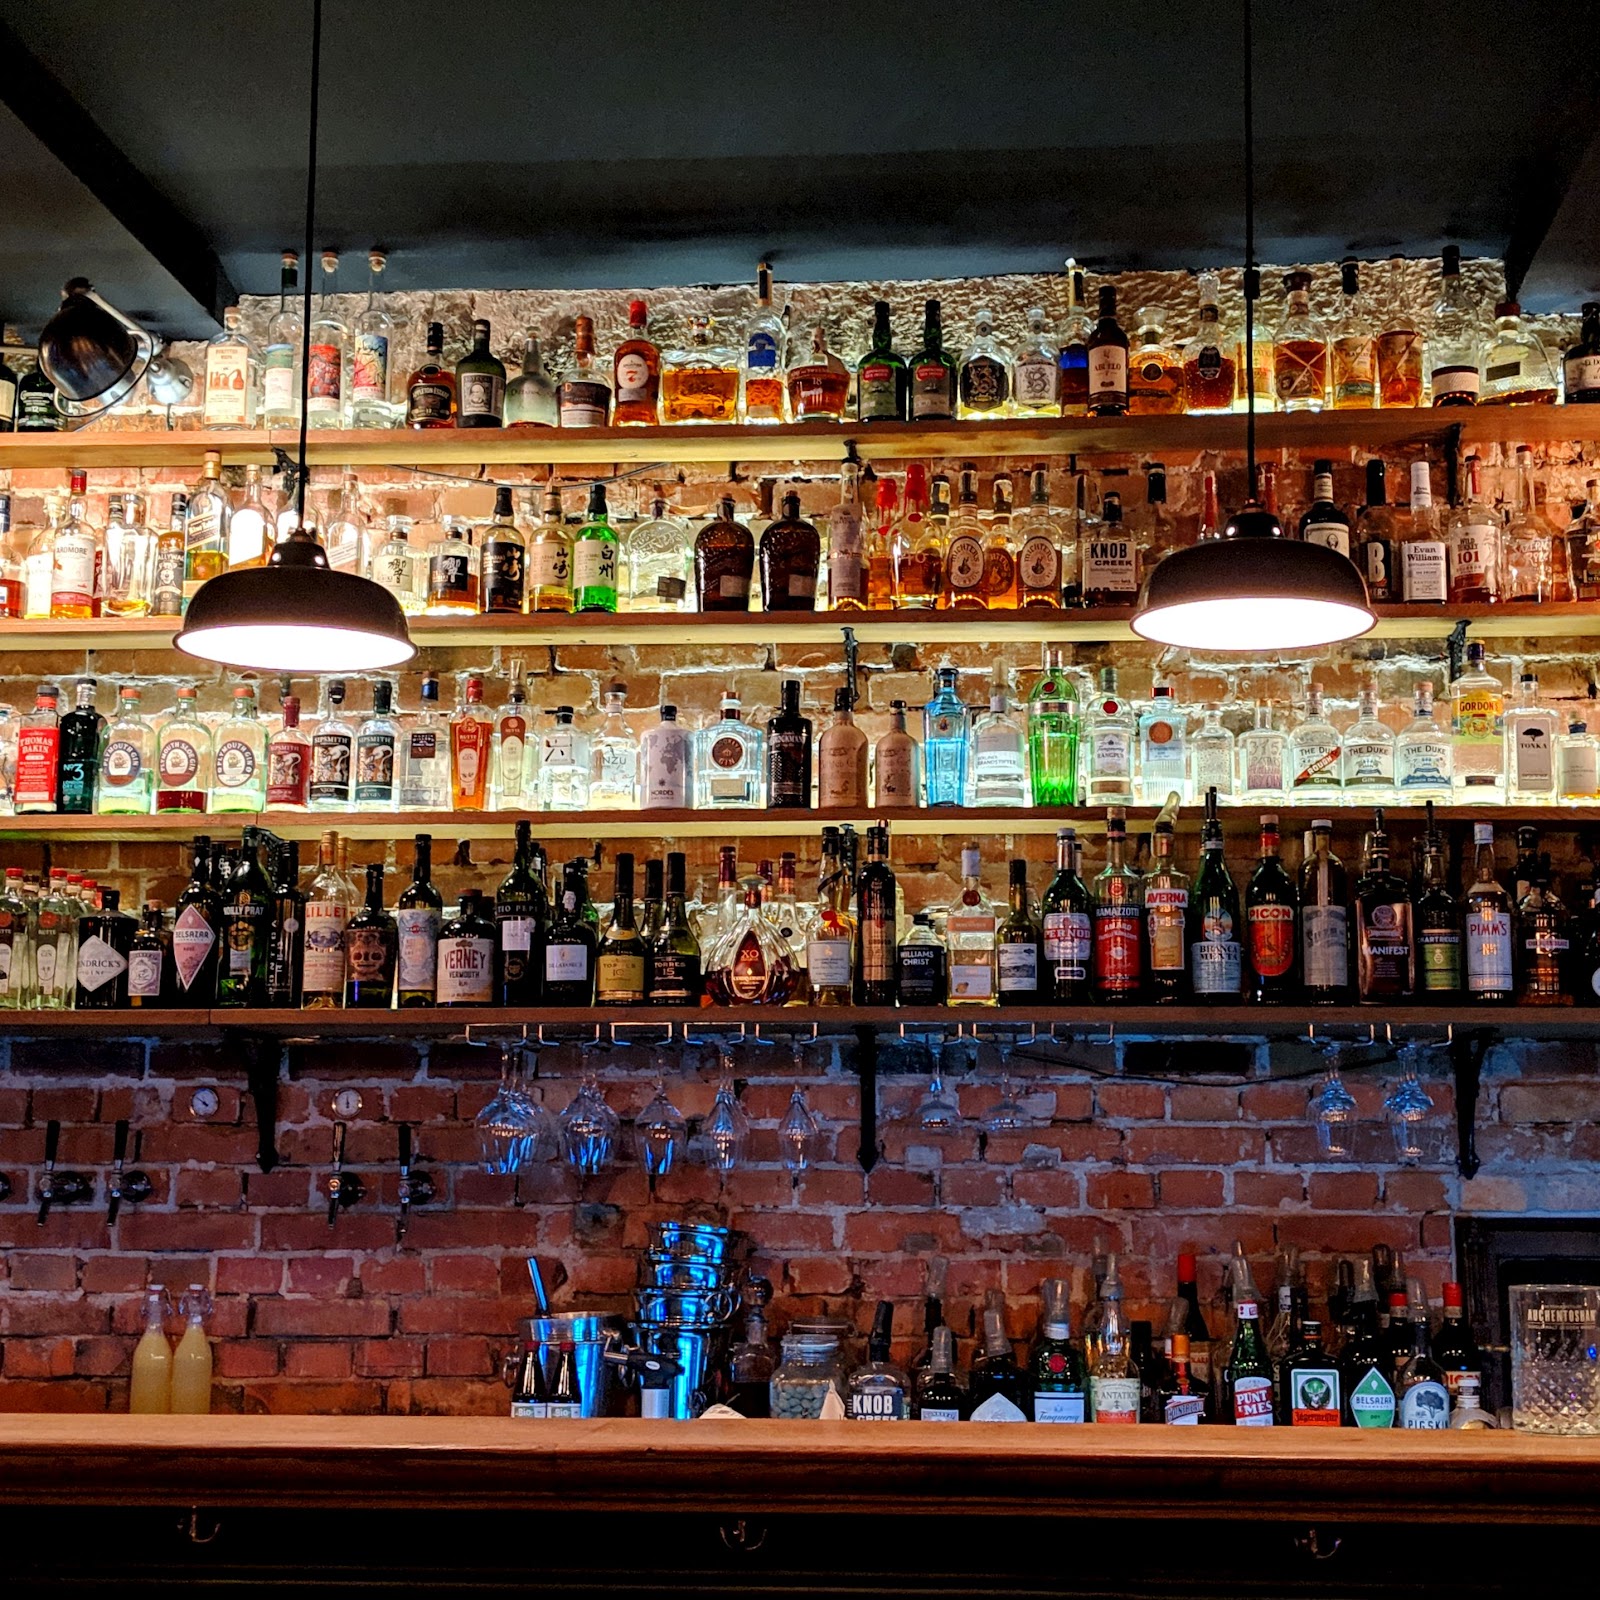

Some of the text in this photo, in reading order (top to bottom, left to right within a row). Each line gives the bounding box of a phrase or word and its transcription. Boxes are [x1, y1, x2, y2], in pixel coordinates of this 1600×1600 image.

[626, 369, 639, 382] 7
[1460, 537, 1475, 545] WILD
[57, 546, 88, 556] ARDMORE
[1090, 543, 1128, 559] KNOB
[1413, 546, 1437, 554] Evan
[599, 544, 614, 581] 白州
[1367, 542, 1386, 583] B
[1457, 551, 1480, 564] 101
[1459, 701, 1500, 712] GORDON'S
[20, 737, 53, 747] THOMAS
[314, 736, 348, 744] SIPSMITH
[103, 743, 140, 767] PLYMOUTH GIN
[217, 742, 247, 767] PLYMOUTH
[1300, 748, 1316, 756] THE
[1349, 746, 1388, 756] THE DUKE
[1405, 745, 1447, 755] THE DUKE
[160, 741, 180, 771] PLYMOUTH
[180, 741, 195, 759] SLOE
[1306, 756, 1333, 776] ROUGH
[1146, 892, 1187, 903] AVERNA
[245, 906, 265, 916] PRAT
[306, 906, 347, 918] LILLET
[1096, 906, 1140, 917] RAMAZZOTTI
[1249, 907, 1291, 919] PICON
[1104, 922, 1132, 932] AMARO
[1470, 920, 1508, 936] PIMM'S
[175, 930, 209, 939] BELSAZAR
[1044, 929, 1091, 939] PERNOD
[741, 949, 759, 957] XO
[1363, 946, 1409, 956] MANIFEST
[79, 958, 121, 968] NDRICK'S
[444, 949, 486, 970] VERNEY
[902, 958, 930, 966] CHRIST
[449, 970, 480, 979] VERMOUTH
[663, 968, 675, 976] 15
[1527, 1308, 1597, 1322] AUCHENTOSHAN
[1235, 1390, 1268, 1405] PUNT
[1355, 1396, 1392, 1404] BELSAZAR
[852, 1394, 893, 1415] KNOB
[1244, 1401, 1273, 1416] MES
[518, 1407, 532, 1417] Bio
[554, 1408, 569, 1417] Bio
